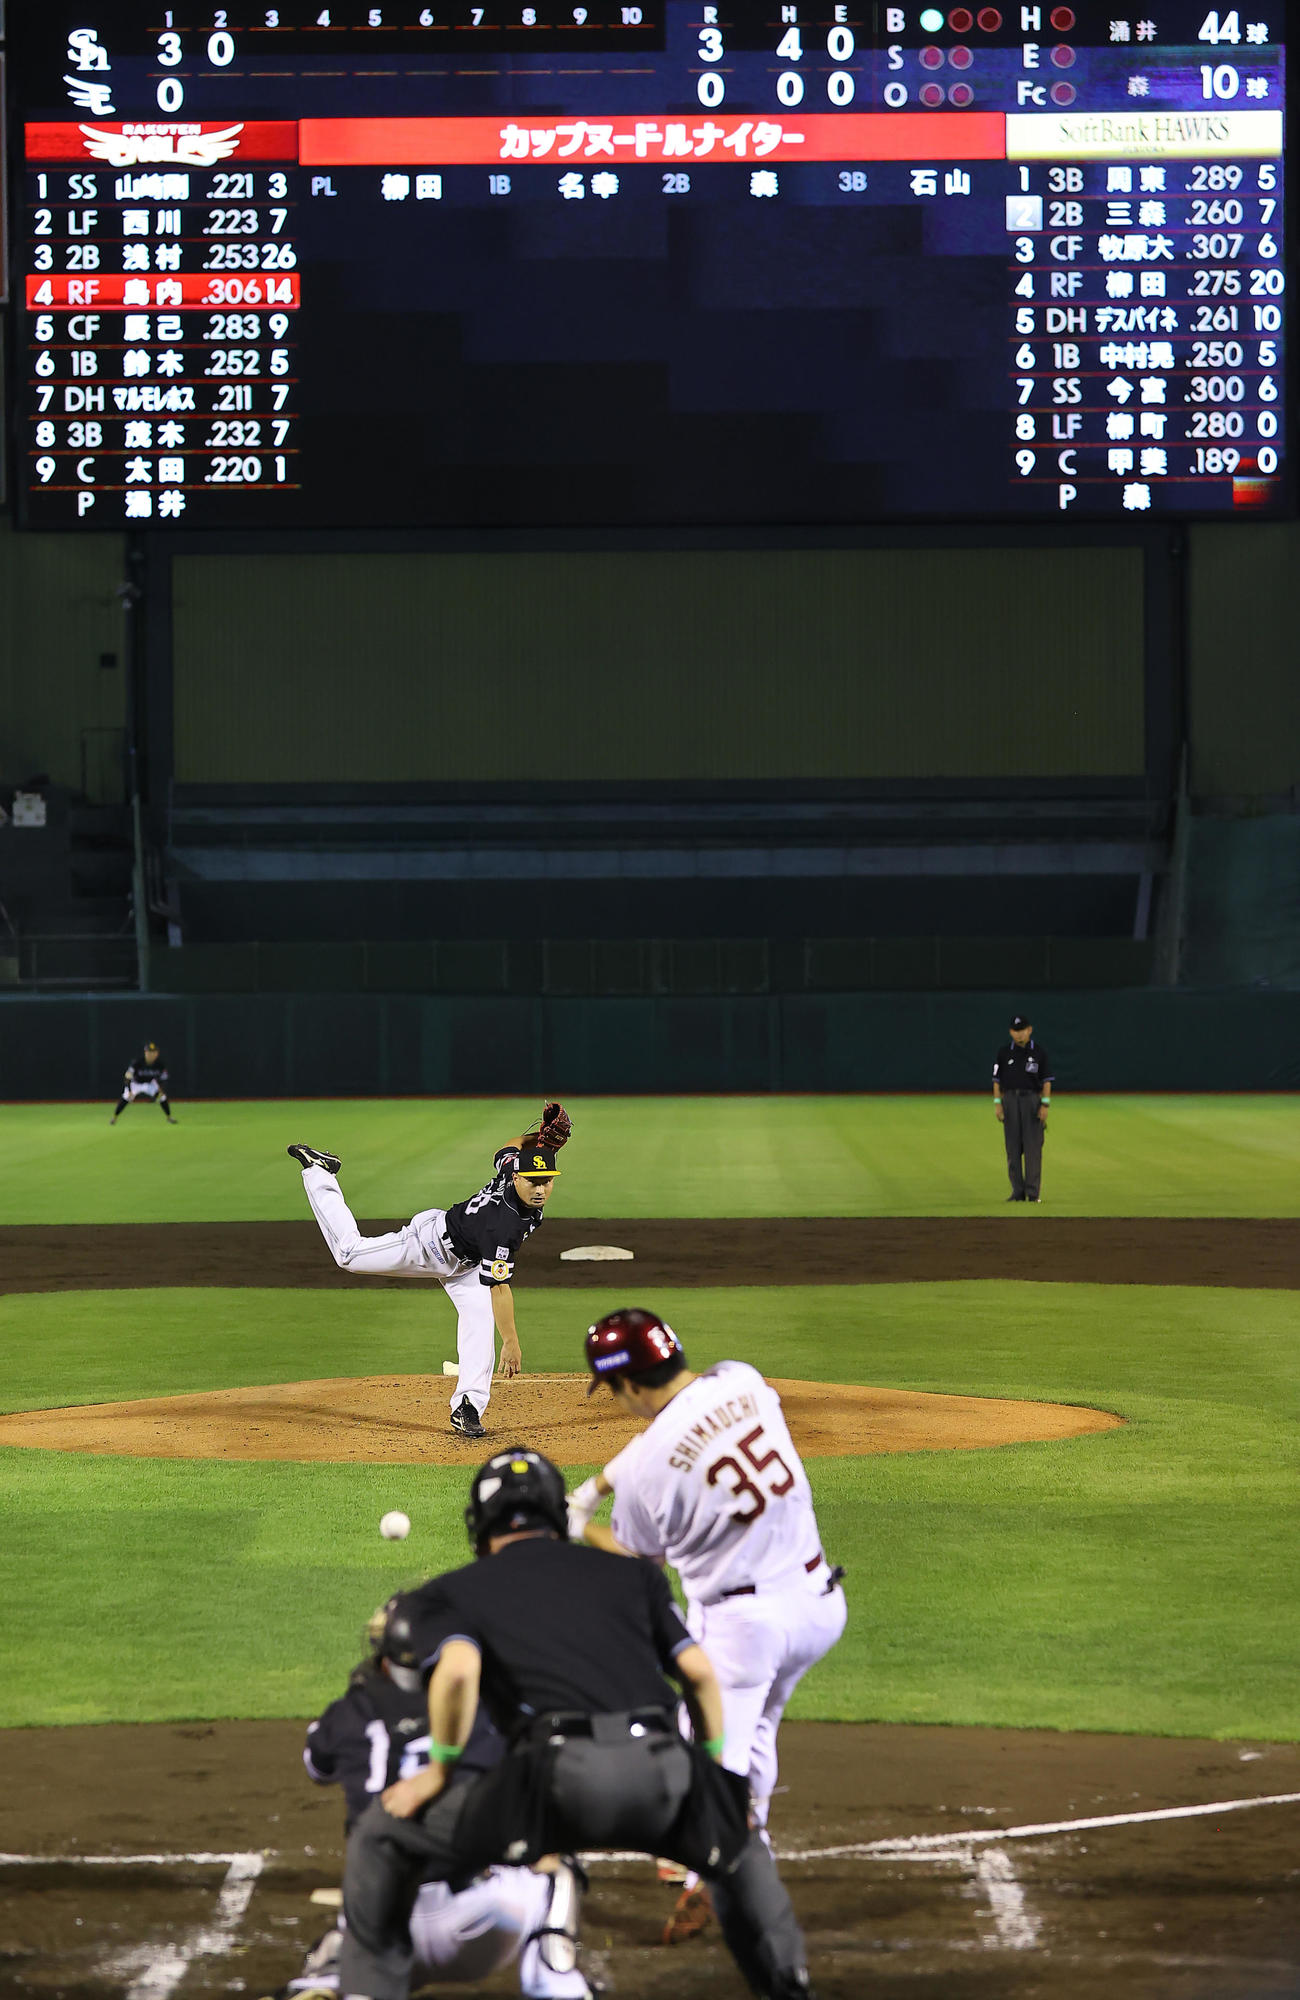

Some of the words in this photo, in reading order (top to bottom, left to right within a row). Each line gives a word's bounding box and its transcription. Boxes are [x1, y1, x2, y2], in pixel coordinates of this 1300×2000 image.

[165, 11, 172, 27] 1
[215, 11, 227, 27] 2
[266, 10, 278, 27] 3
[317, 10, 330, 27] 4
[369, 10, 381, 26] 5
[420, 9, 433, 26] 6
[471, 9, 483, 25] 7
[522, 8, 536, 25] 8
[573, 8, 587, 24] 9
[621, 7, 642, 24] 10
[704, 6, 717, 23] R
[782, 6, 796, 23] H
[835, 5, 847, 22] E
[887, 8, 905, 32] B
[1021, 6, 1040, 31] H
[157, 33, 182, 66] 3
[208, 32, 234, 66] 0
[698, 28, 723, 62] 3
[776, 27, 802, 61] 4
[827, 27, 853, 61] 0
[888, 45, 903, 70] S
[1024, 43, 1039, 68] E
[157, 78, 183, 112] 0
[698, 72, 724, 107] 0
[777, 72, 803, 106] 0
[828, 71, 854, 105] 0
[884, 82, 907, 107] O
[499, 121, 806, 160] カップヌードルナイター
[1155, 117, 1230, 141] HAWKS
[38, 174, 46, 199] 1
[69, 175, 97, 199] SS
[207, 174, 253, 198] .221
[269, 173, 287, 198] 3
[312, 177, 336, 196] PL
[381, 174, 441, 200] 柳田
[489, 175, 510, 194] 1B
[558, 172, 619, 199] 名幸
[663, 174, 690, 193] 2B
[839, 172, 867, 191] 3B
[910, 169, 969, 195] 石山
[1019, 166, 1028, 191] 1
[1049, 168, 1083, 192] 3B
[1107, 166, 1166, 192] 周東
[1185, 165, 1242, 190] .289
[1258, 165, 1275, 190] 5
[35, 209, 52, 234] 2
[68, 210, 97, 235] LF
[122, 209, 180, 235] 西川
[203, 209, 258, 234] .223
[270, 209, 287, 234] 7
[1015, 202, 1036, 227] 2
[1049, 202, 1083, 226] 2B
[1106, 200, 1166, 226] 三森
[1185, 199, 1242, 225] .260
[1259, 199, 1276, 224] 7
[35, 245, 53, 270] 3
[66, 245, 99, 269] 2B
[122, 244, 182, 270] 浅村
[203, 244, 263, 269] .253
[262, 244, 296, 269] 26
[1016, 237, 1034, 262] 3
[1050, 235, 1082, 260] CF
[1098, 234, 1174, 261] 牧原大
[1186, 233, 1244, 259] .307
[1258, 233, 1277, 258] 6
[34, 280, 53, 305] 4
[68, 280, 99, 304] RF
[123, 278, 182, 306] 島内
[202, 279, 262, 304] .306
[265, 279, 293, 305] 14
[1015, 273, 1034, 298] 4
[1051, 272, 1082, 297] RF
[1106, 271, 1165, 298] 柳田
[1188, 270, 1241, 296] .275
[1250, 269, 1284, 295] 20
[35, 315, 53, 341] 5
[68, 315, 99, 340] CF
[203, 314, 260, 339] .283
[269, 314, 288, 339] 9
[1016, 308, 1034, 334] 5
[1047, 308, 1086, 333] DH
[1095, 306, 1178, 332] デスパイネ
[1190, 306, 1237, 331] .261
[1253, 305, 1281, 331] 10
[36, 351, 54, 376] 6
[71, 351, 97, 376] 1B
[123, 350, 183, 377] 鈴木
[205, 350, 260, 375] .252
[270, 349, 288, 375] 5
[1016, 344, 1035, 369] 6
[1053, 344, 1080, 368] 1B
[1100, 342, 1174, 369] 中村晃
[1186, 341, 1243, 367] .250
[1258, 341, 1276, 366] 5
[36, 386, 54, 411] 7
[65, 386, 104, 411] DH
[212, 385, 251, 410] .211
[271, 385, 289, 410] 7
[1017, 379, 1034, 404] 7
[1053, 378, 1081, 403] SS
[1107, 376, 1166, 404] 今宮
[1184, 376, 1244, 402] .300
[1258, 376, 1277, 401] 6
[36, 421, 55, 447] 8
[68, 422, 102, 447] 3B
[124, 421, 184, 448] 茂木
[205, 421, 261, 446] .232
[272, 420, 289, 446] 7
[1016, 414, 1035, 440] 8
[1053, 414, 1082, 439] LF
[1106, 412, 1167, 440] 柳町
[1185, 412, 1243, 437] .280
[1258, 411, 1277, 437] 0
[36, 457, 55, 482] 9
[77, 458, 94, 482] C
[125, 456, 184, 483] 太田
[205, 456, 261, 482] .220
[275, 456, 285, 481] 1
[1016, 450, 1035, 475] 9
[1059, 450, 1076, 474] C
[1190, 448, 1240, 474] .189
[1258, 447, 1277, 473] 0
[78, 492, 94, 516] P
[1060, 484, 1076, 509] P
[669, 1393, 760, 1472] SHIMAUCHI
[706, 1425, 795, 1523] 35
